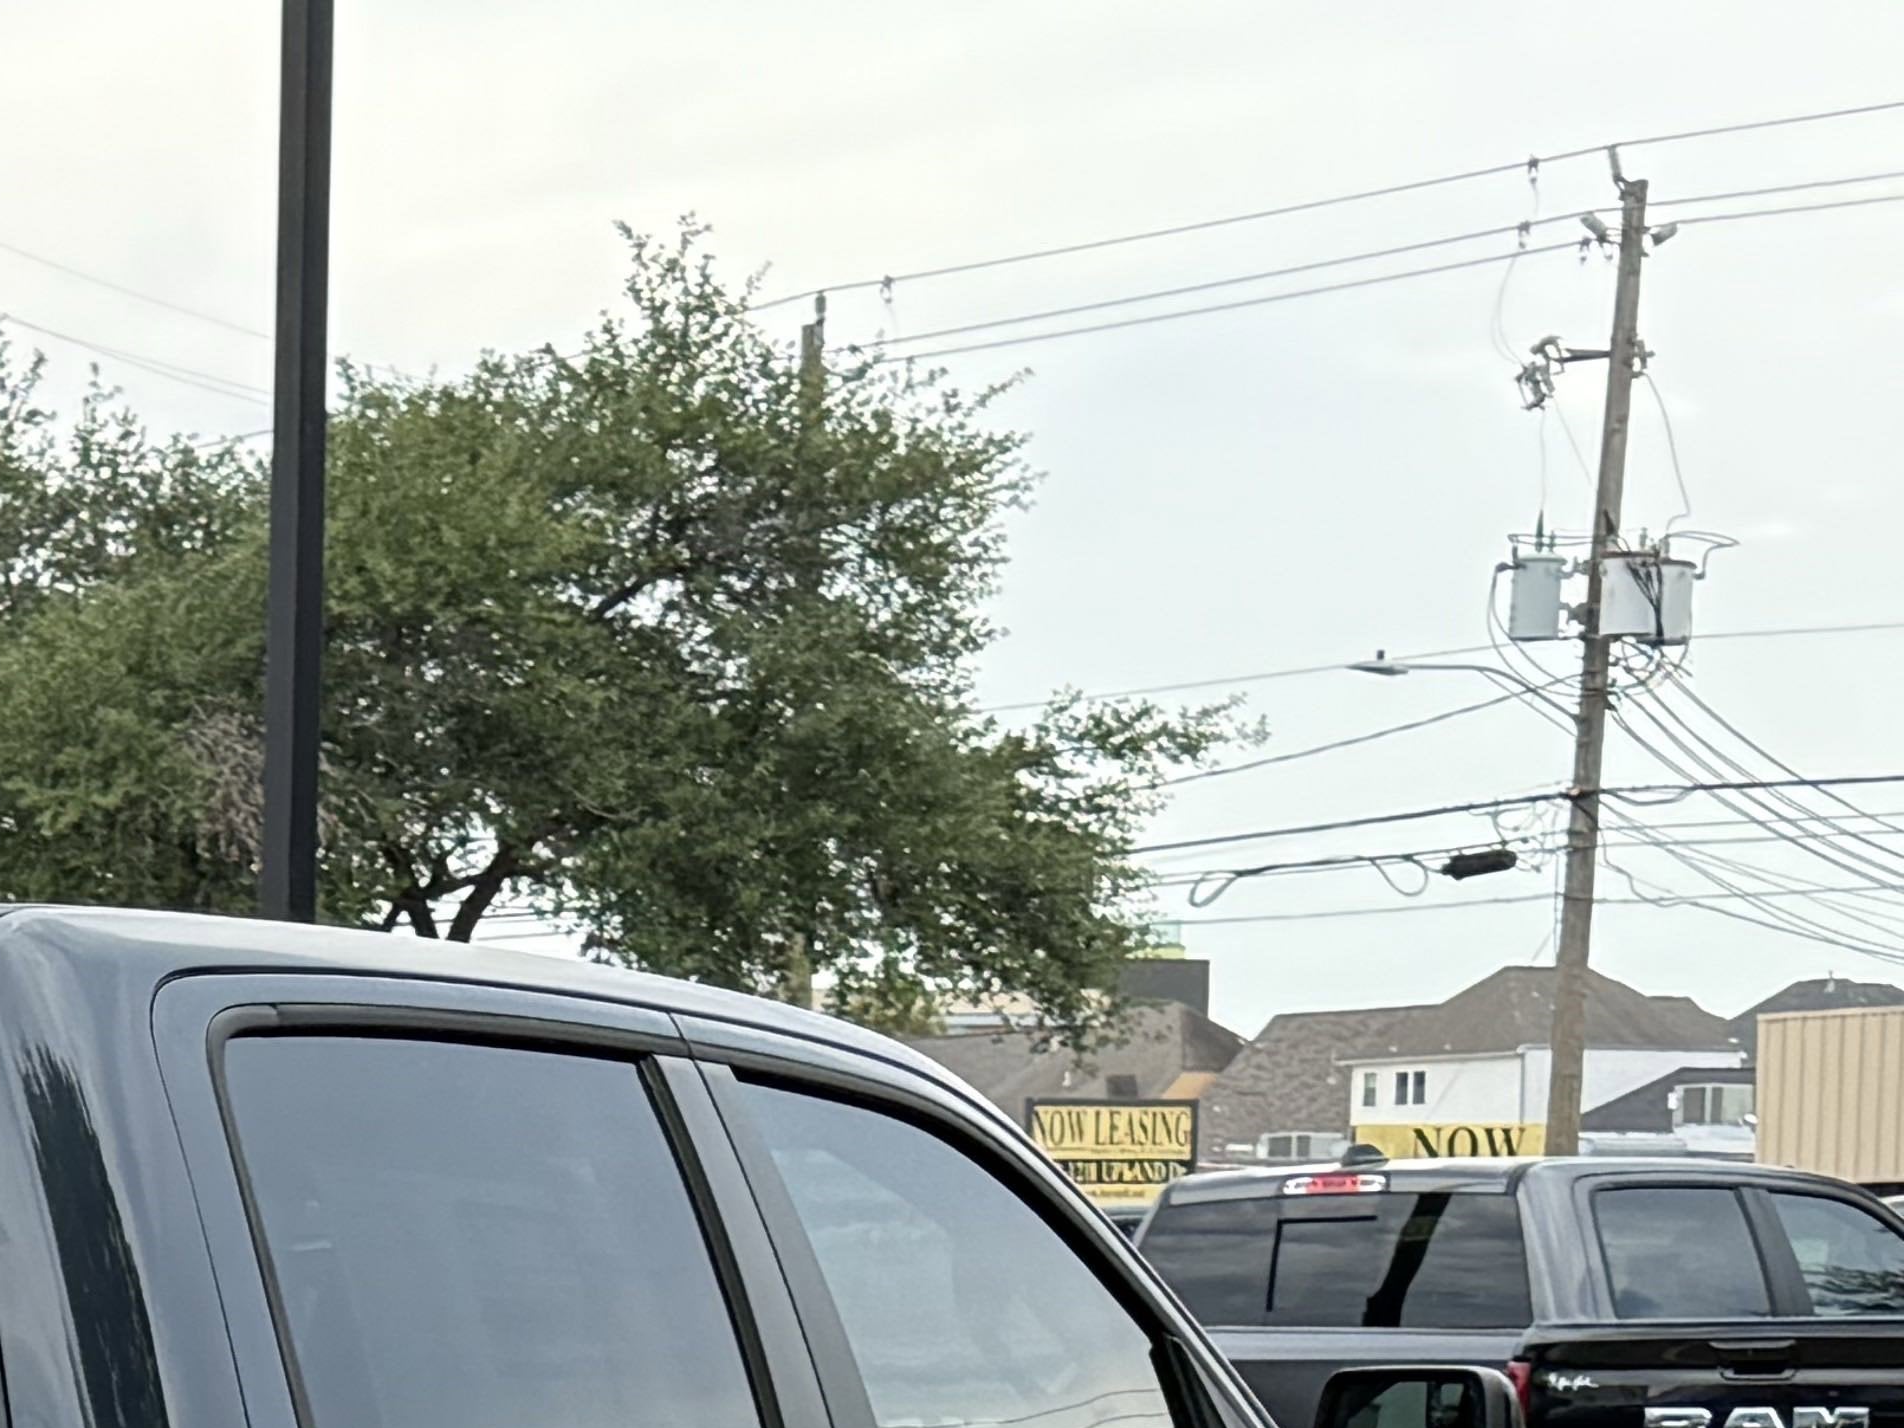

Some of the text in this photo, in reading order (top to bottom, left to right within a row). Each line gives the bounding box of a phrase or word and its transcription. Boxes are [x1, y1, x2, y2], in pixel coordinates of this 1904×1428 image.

[1033, 1110, 1191, 1147] NOW LEASING
[1413, 1126, 1526, 1157] NOW
